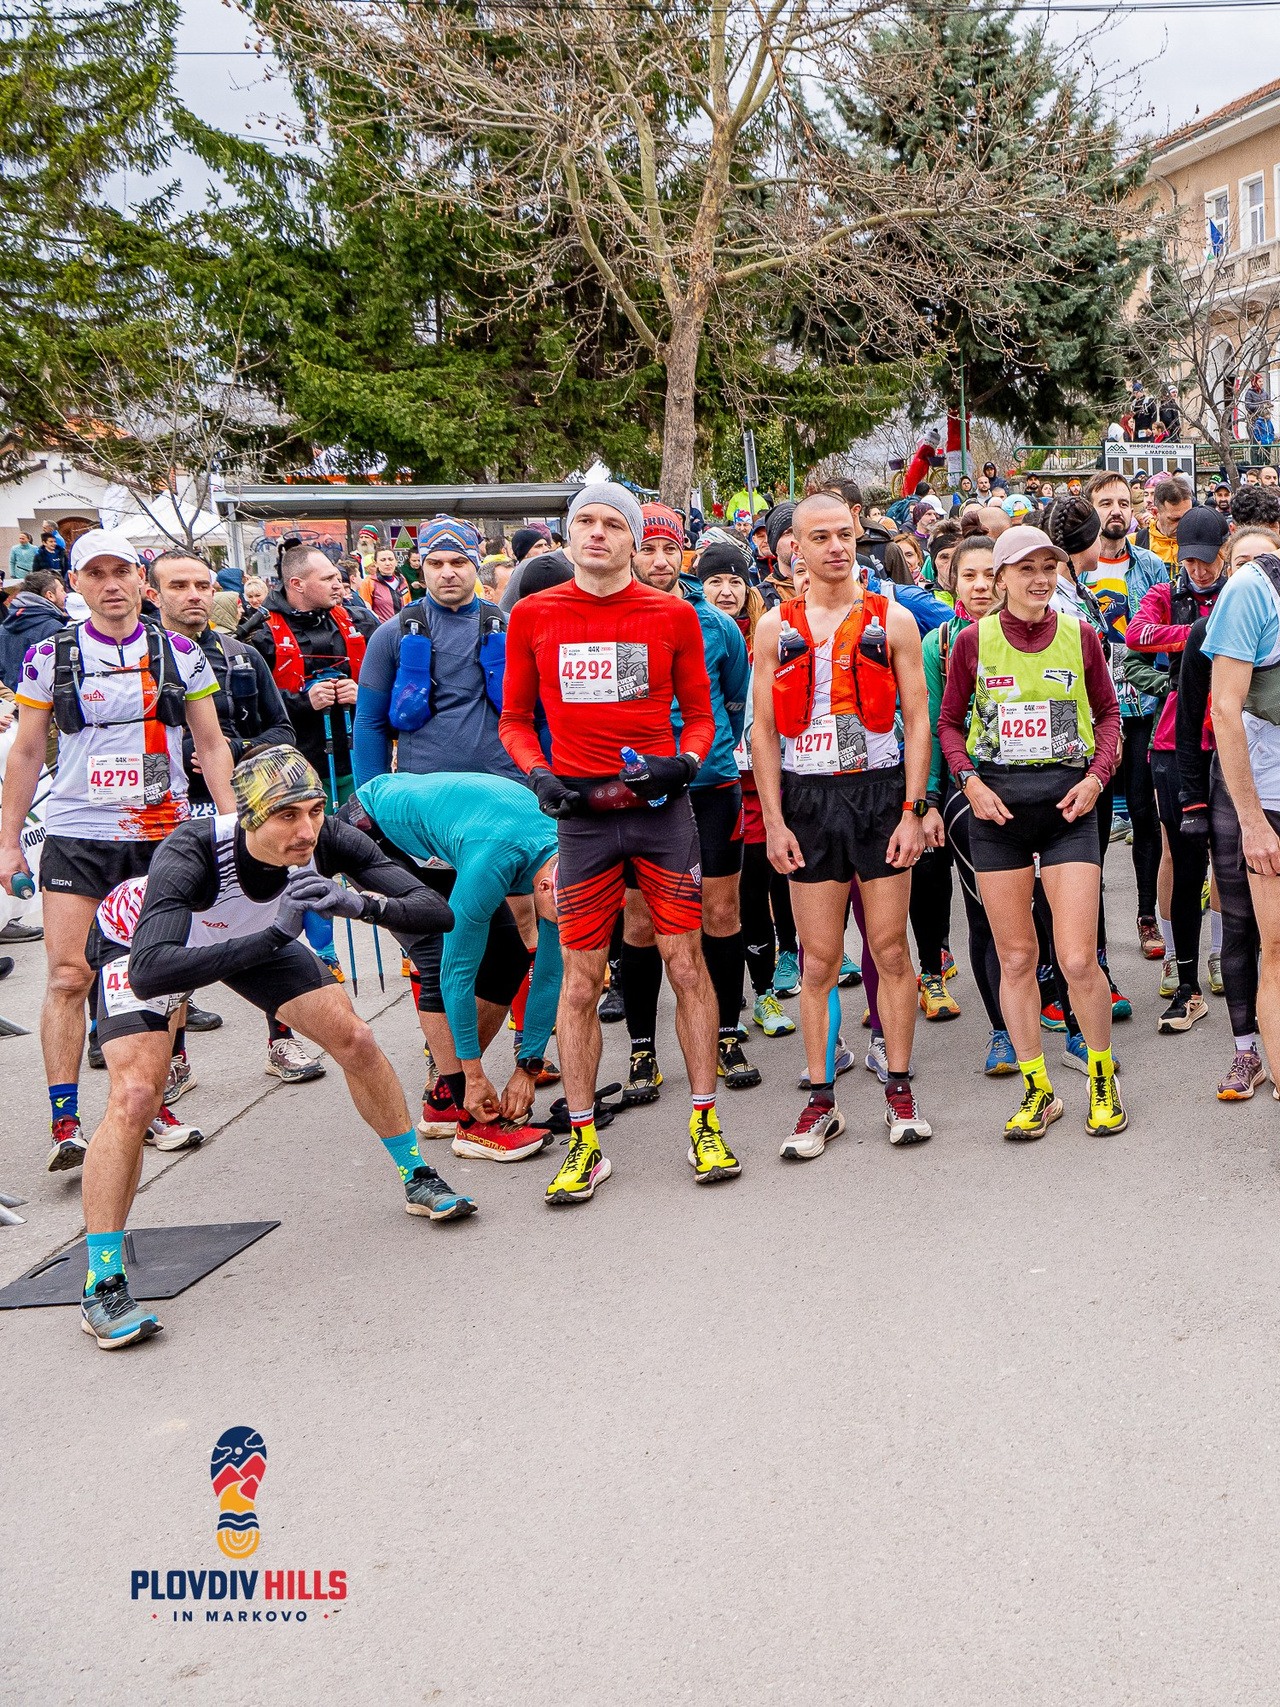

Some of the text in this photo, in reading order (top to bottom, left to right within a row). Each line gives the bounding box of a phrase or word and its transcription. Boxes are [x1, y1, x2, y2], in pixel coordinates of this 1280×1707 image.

[562, 660, 612, 680] 4292
[1001, 718, 1047, 738] 4262
[796, 732, 832, 754] 4277
[90, 770, 139, 787] 4279
[188, 802, 217, 818] 223
[106, 970, 131, 991] 42
[466, 1133, 506, 1154] SPORTIVA
